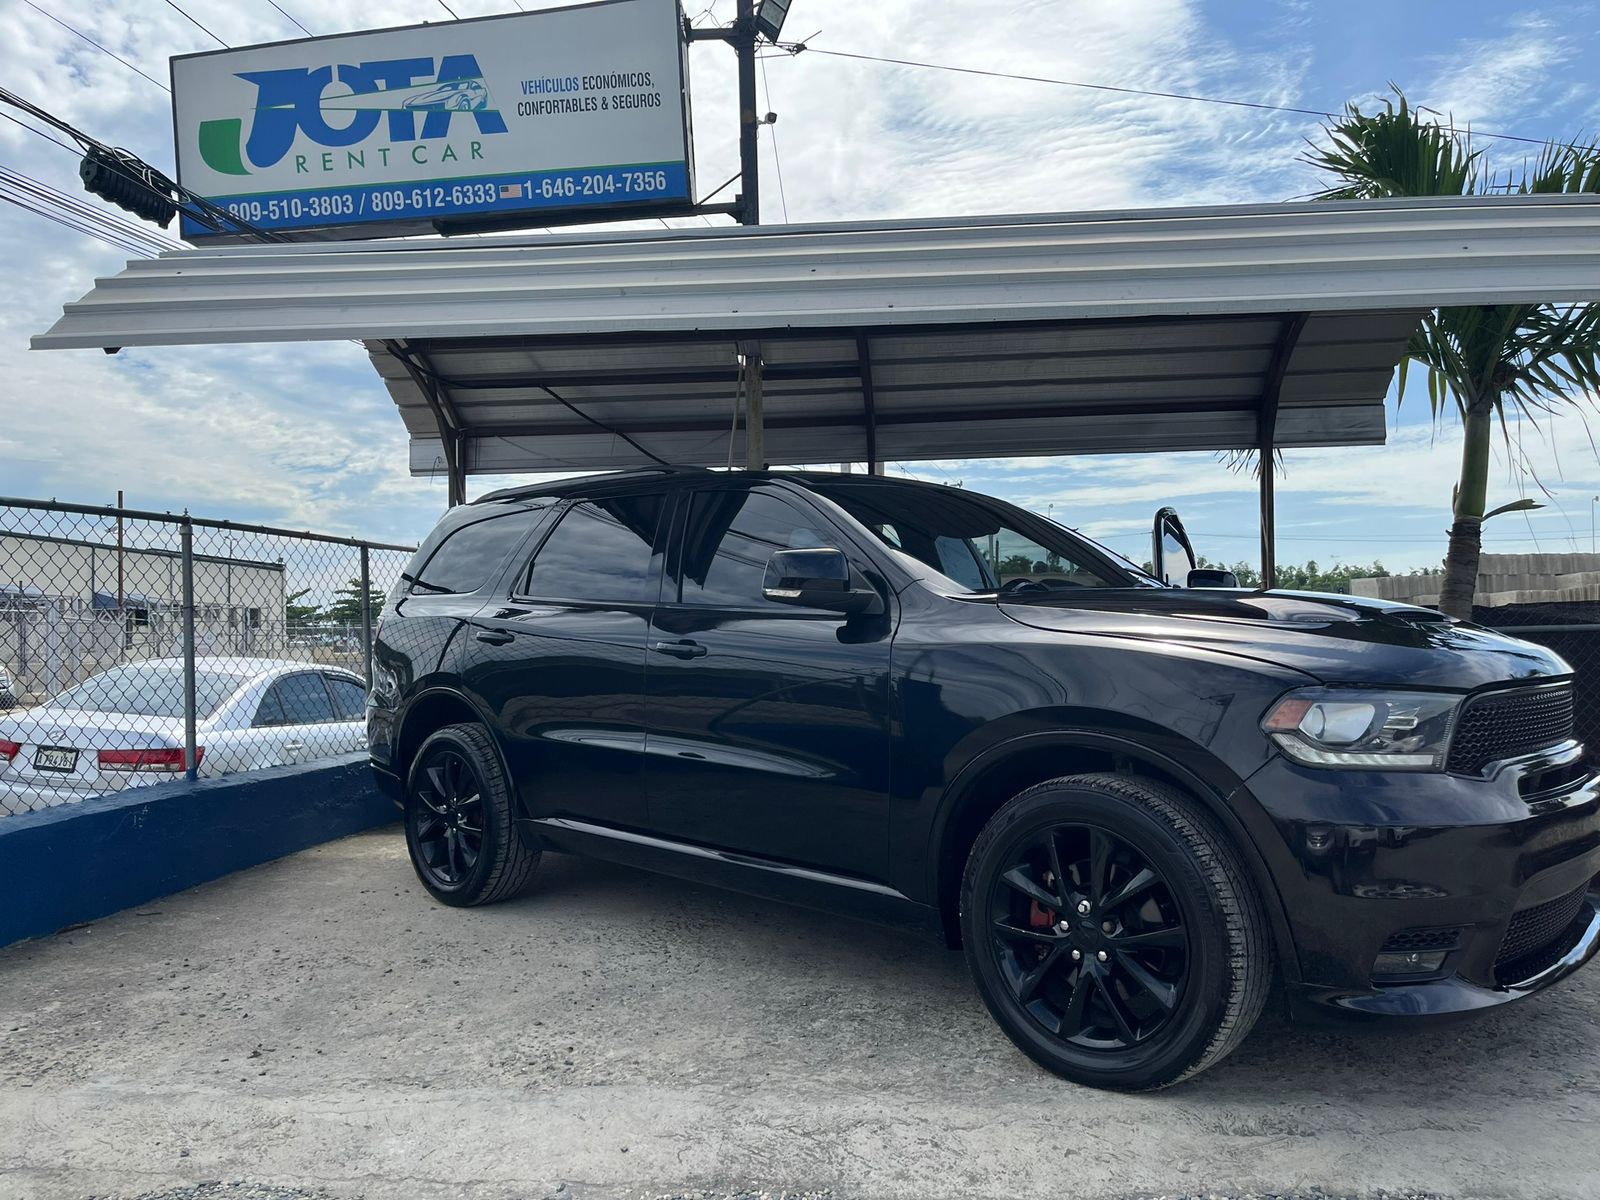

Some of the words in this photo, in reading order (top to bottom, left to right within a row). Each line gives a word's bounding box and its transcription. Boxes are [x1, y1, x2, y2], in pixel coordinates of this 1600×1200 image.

[521, 76, 579, 95] VEHÍCULOS
[582, 71, 655, 91] ECONÓMICOS,
[198, 54, 509, 175] JOTA
[517, 96, 598, 117] CONFORTABLES
[601, 96, 609, 110] &
[612, 92, 661, 109] SEGUROS
[295, 147, 391, 174] RENT
[411, 141, 485, 165] CAR
[228, 194, 354, 222] 809-510-3803
[358, 192, 366, 215] /
[371, 183, 496, 213] 809-612-6333
[523, 170, 667, 200] 1-646-204-7356
